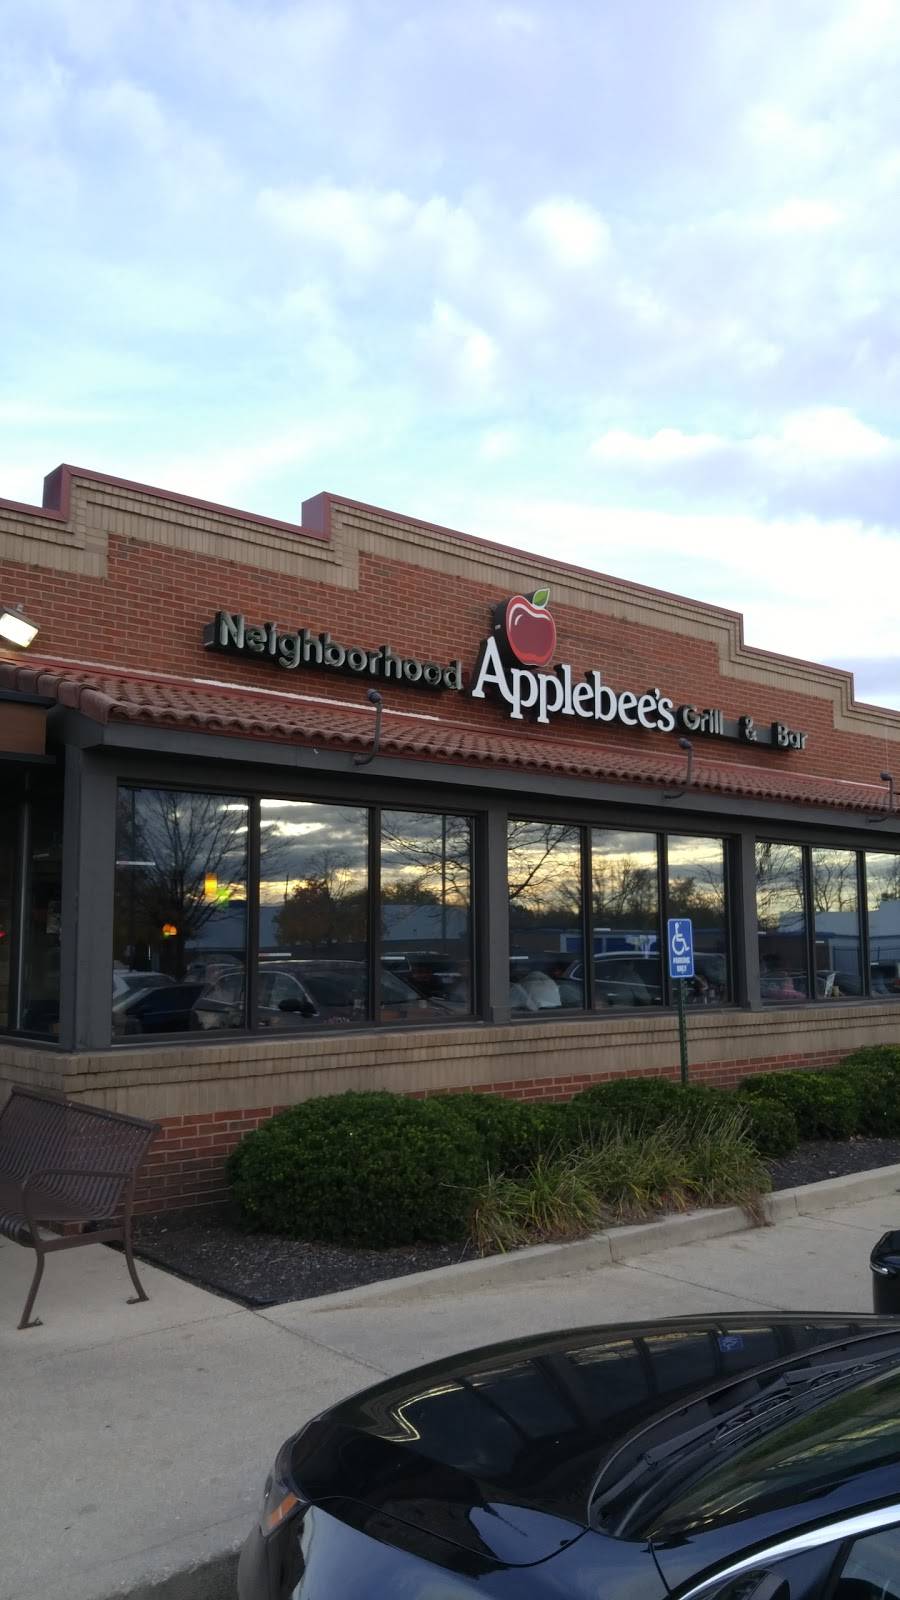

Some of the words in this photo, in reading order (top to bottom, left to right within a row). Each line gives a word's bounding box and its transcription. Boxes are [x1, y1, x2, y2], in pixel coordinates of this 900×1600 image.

[213, 610, 463, 691] Neighborhood
[472, 635, 675, 733] Applebee's
[681, 705, 724, 736] Grill
[743, 715, 758, 742] &
[776, 722, 809, 751] Bar
